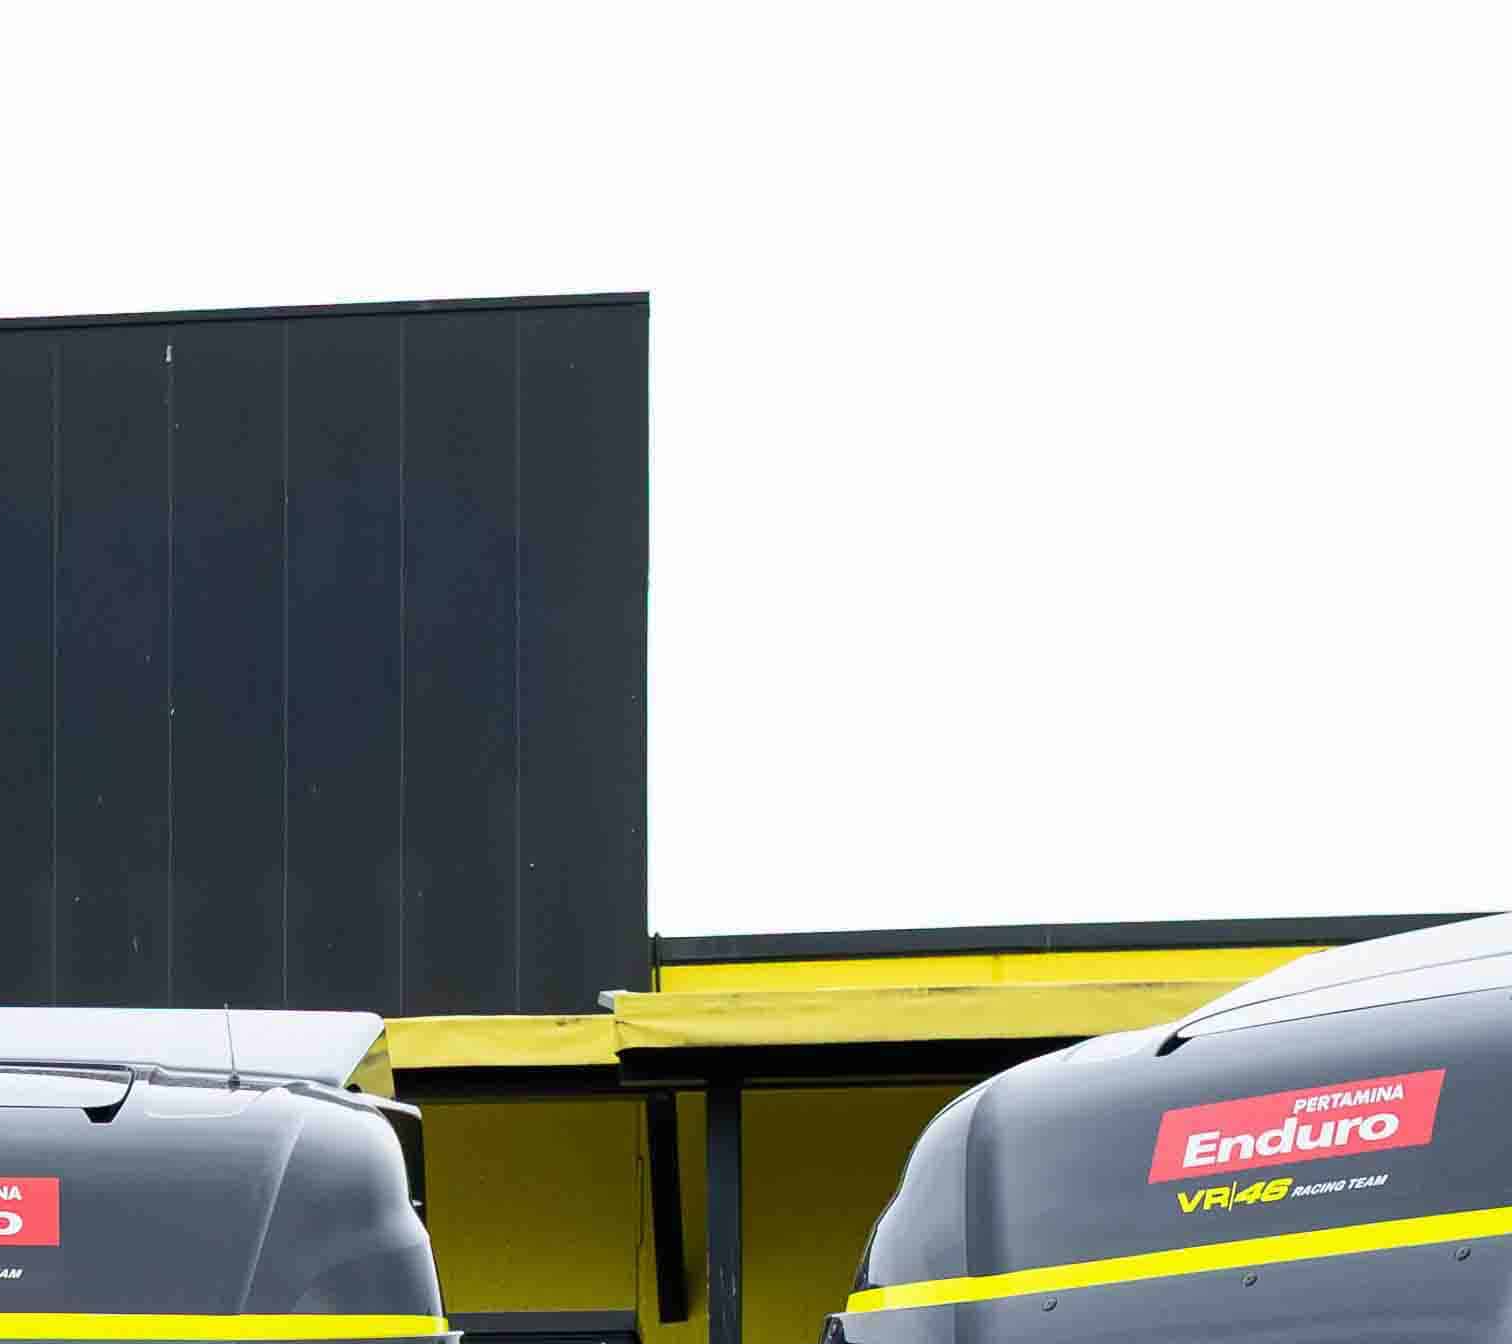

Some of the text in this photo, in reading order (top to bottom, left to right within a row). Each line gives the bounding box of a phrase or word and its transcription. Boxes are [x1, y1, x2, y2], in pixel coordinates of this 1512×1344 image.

[1293, 1083, 1404, 1114] PERTAMINA
[1182, 1113, 1399, 1168] Enduro
[1291, 1180, 1345, 1198] RACING
[1347, 1174, 1388, 1189] TEAM
